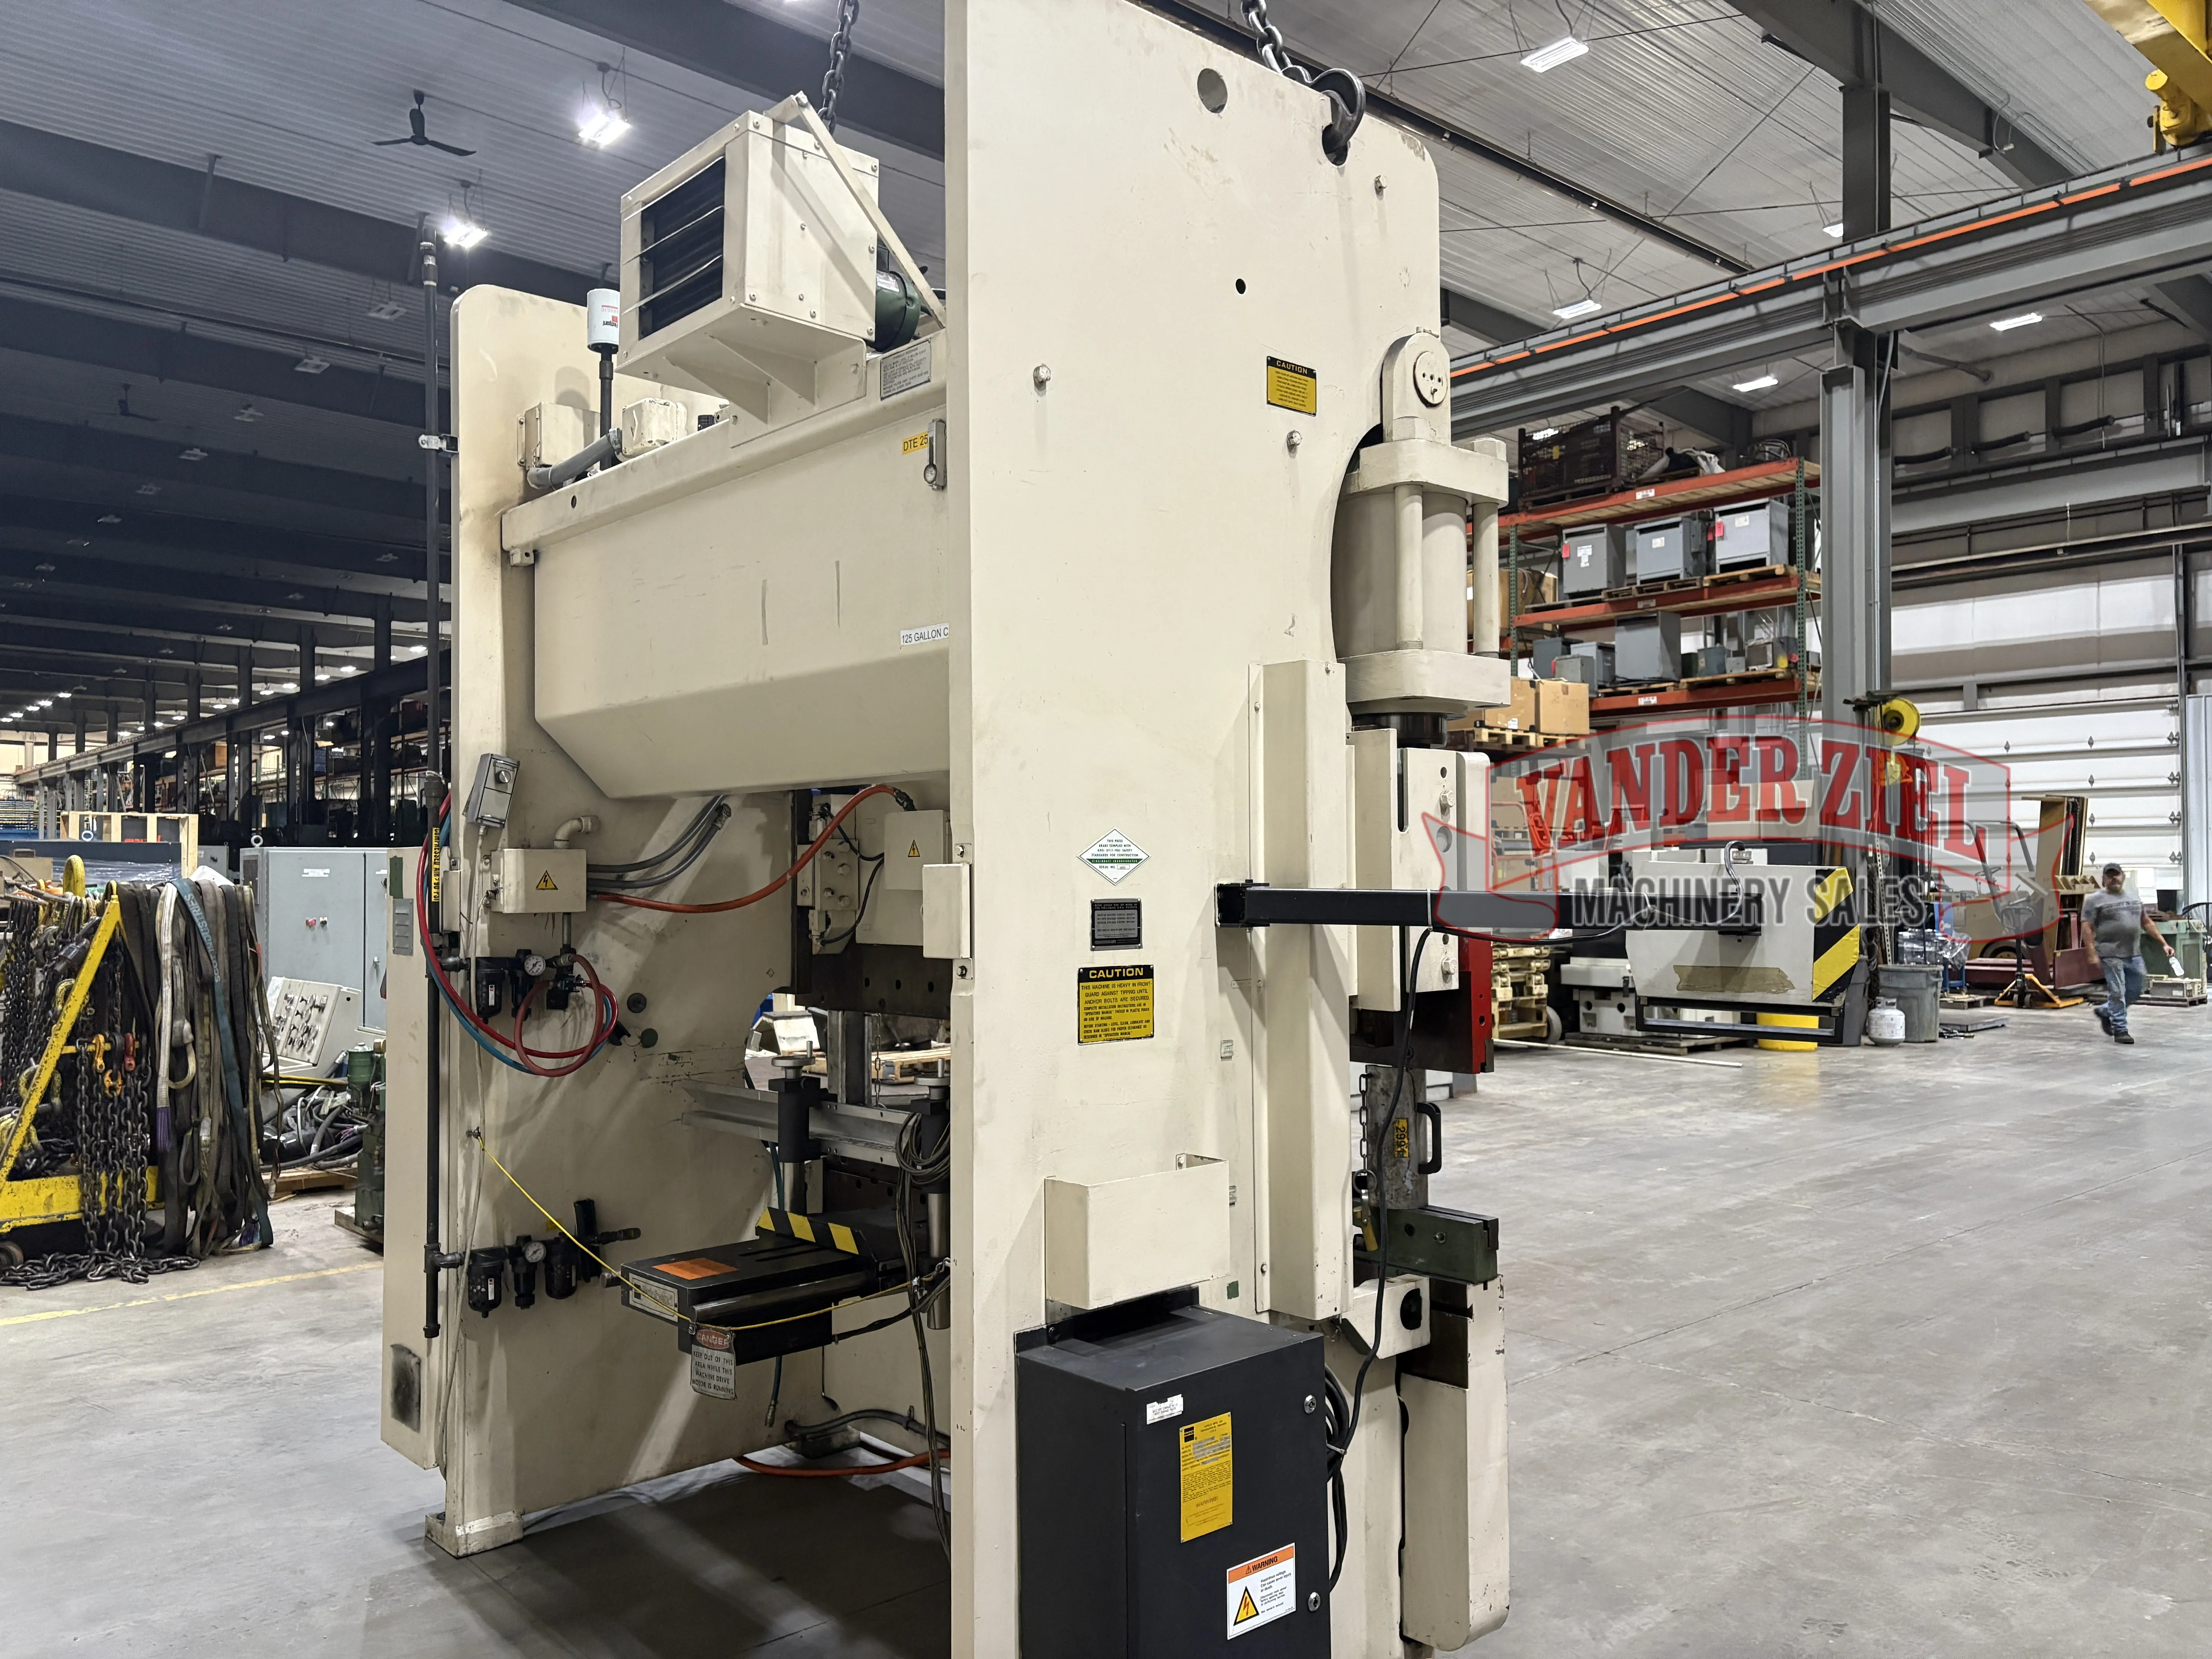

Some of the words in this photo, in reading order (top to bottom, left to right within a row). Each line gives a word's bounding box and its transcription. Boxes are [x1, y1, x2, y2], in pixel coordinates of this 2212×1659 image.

[1277, 361, 1307, 374] CAUTION
[904, 438, 918, 451] DTE
[920, 434, 928, 445] 25
[902, 634, 912, 643] 125
[914, 629, 941, 641] GALLON
[1089, 968, 1143, 979] CAUTION
[698, 1334, 729, 1346] DANGER
[704, 1353, 713, 1362] OUT
[707, 1364, 720, 1372] WHILE
[696, 1370, 714, 1381] MACHINE
[716, 1375, 730, 1384] DRIVE
[692, 1379, 706, 1388] MOTOR
[714, 1384, 733, 1394] RUNNING
[1252, 1556, 1278, 1571] WARNING
